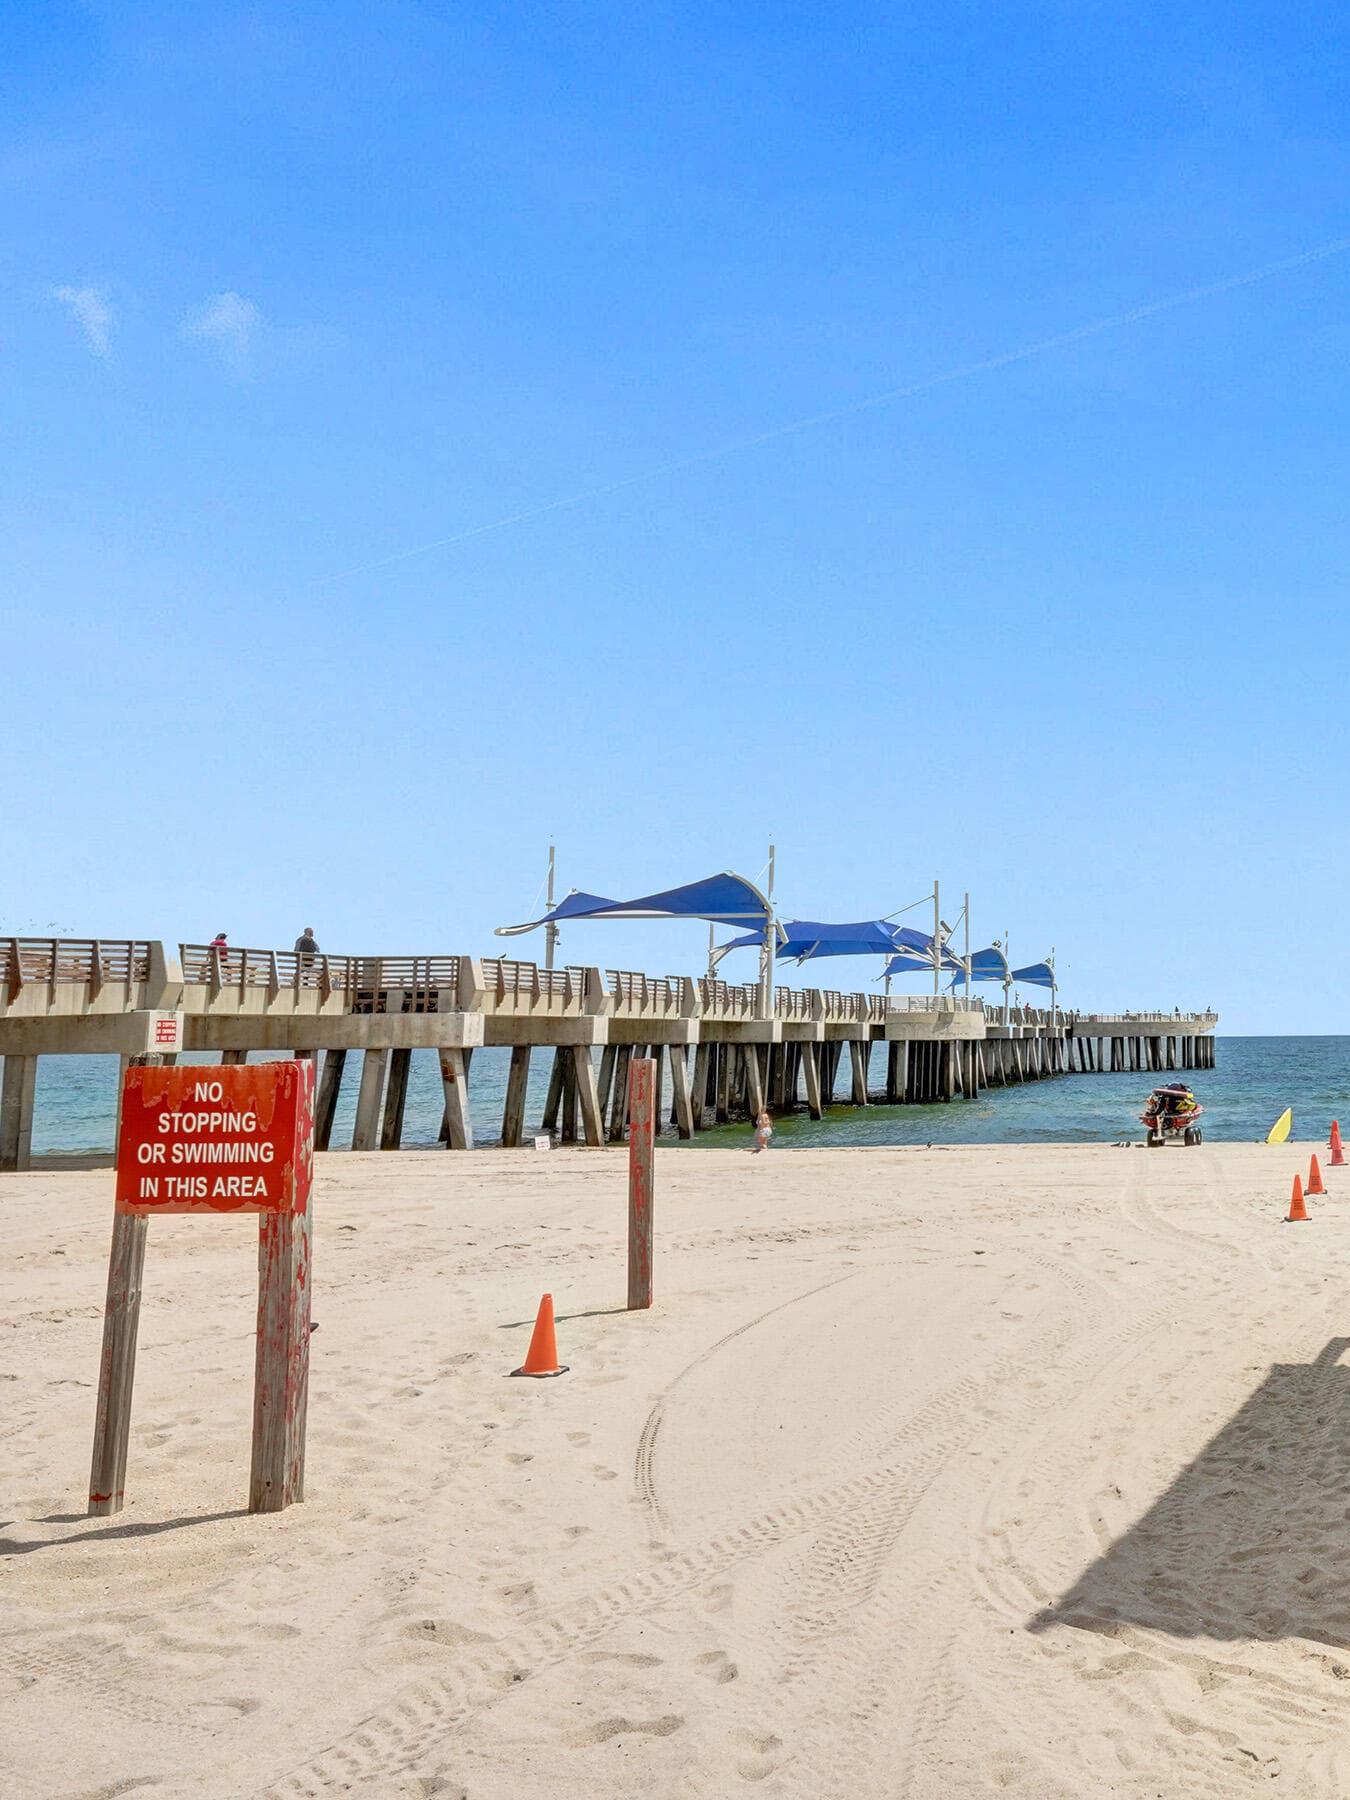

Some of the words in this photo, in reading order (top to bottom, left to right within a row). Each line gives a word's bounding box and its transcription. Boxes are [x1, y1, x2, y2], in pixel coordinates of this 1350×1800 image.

[194, 1082, 223, 1102] NO
[158, 1112, 256, 1133] STOPPING
[137, 1143, 166, 1164] OR
[171, 1142, 274, 1163] SWIMMING
[140, 1177, 158, 1198] IN
[165, 1177, 208, 1198] THIS
[212, 1176, 268, 1197] AREA
